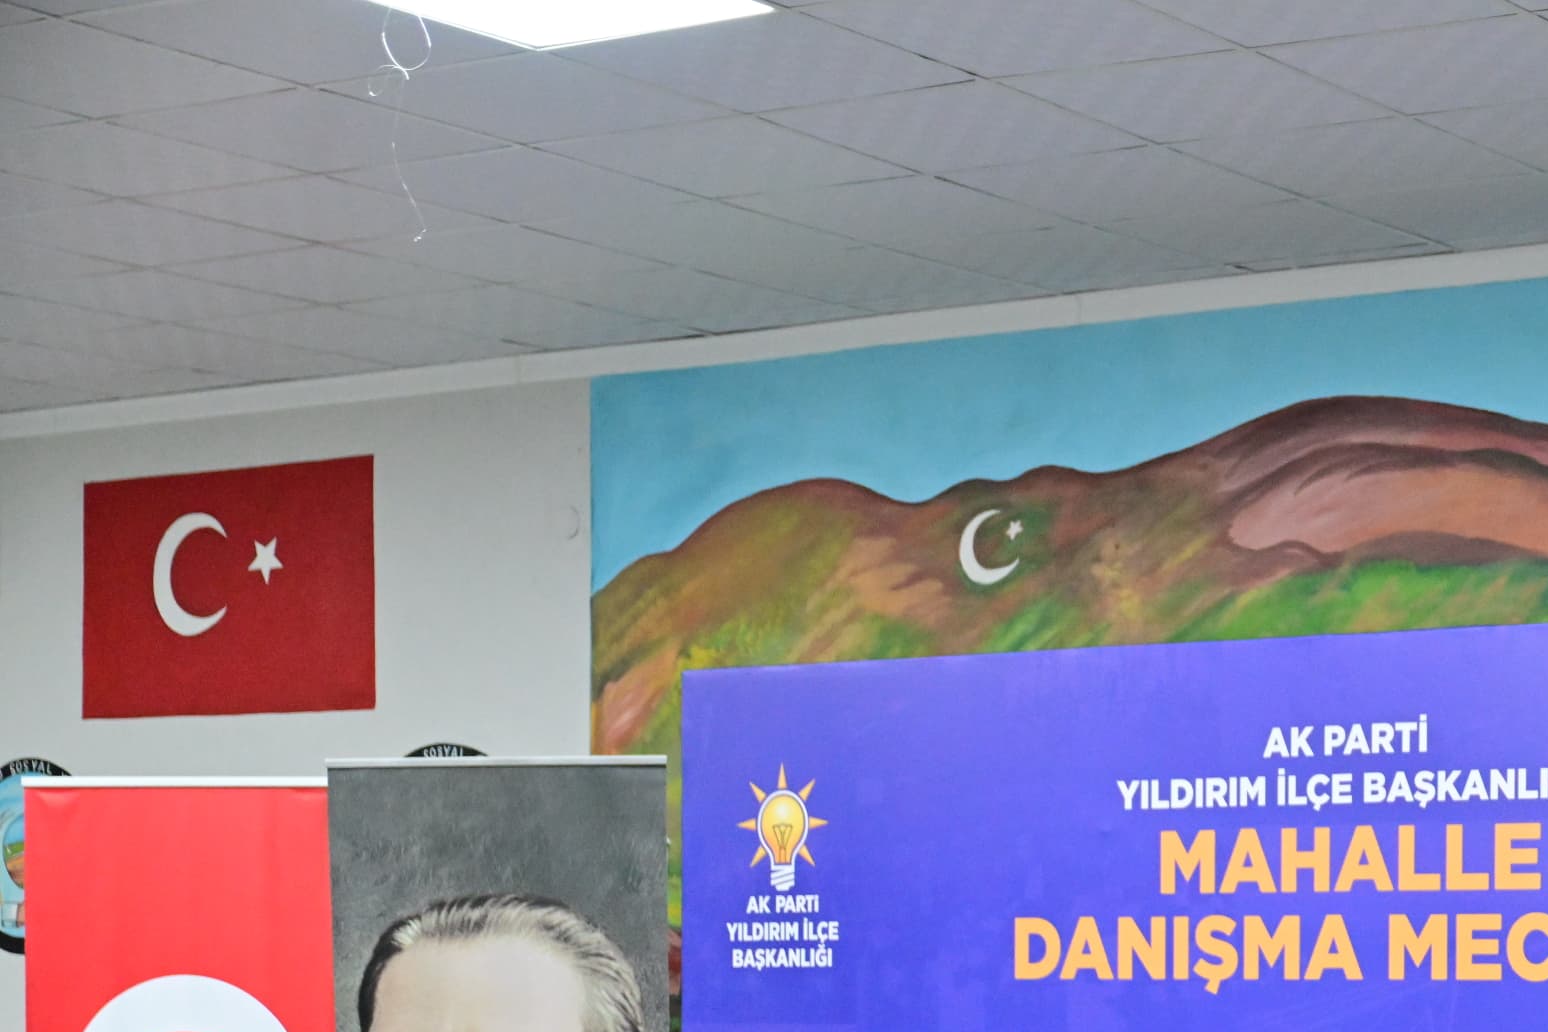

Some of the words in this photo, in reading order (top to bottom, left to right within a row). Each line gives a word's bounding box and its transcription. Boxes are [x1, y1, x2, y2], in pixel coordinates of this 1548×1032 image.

[1262, 726, 1315, 758] AK
[1323, 714, 1428, 756] PARTİ
[1116, 776, 1267, 811] YILDIRIM
[1277, 768, 1353, 811] İLÇE
[1160, 822, 1542, 895] MAHALLE
[746, 895, 771, 914] AK
[726, 921, 799, 942] YILDIRIM
[803, 917, 840, 945] İLÇE
[732, 943, 833, 972] BAŞKANLIĞI
[1014, 914, 1364, 995] DANIŞMA
